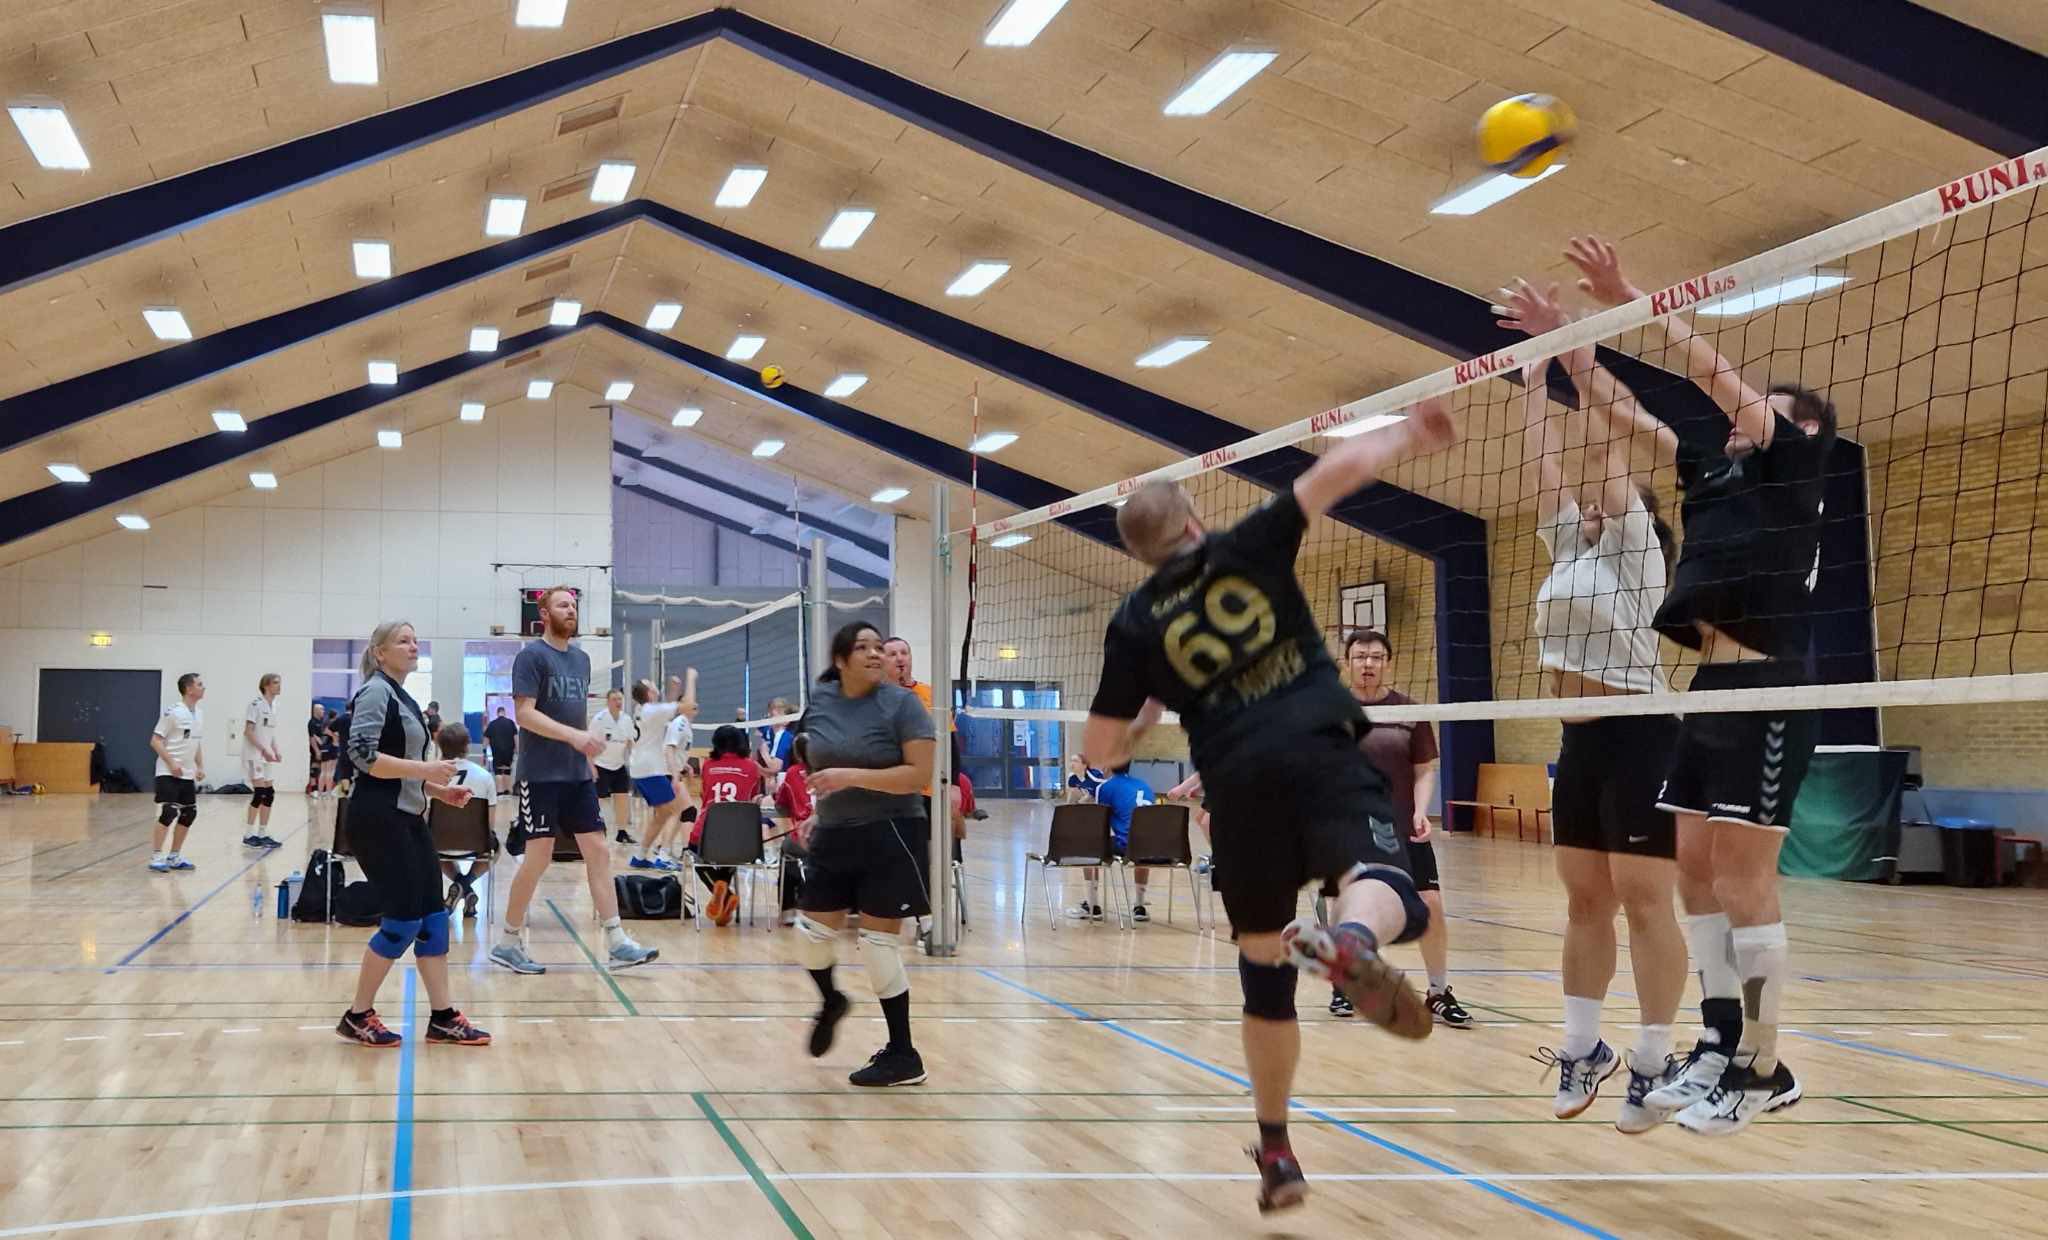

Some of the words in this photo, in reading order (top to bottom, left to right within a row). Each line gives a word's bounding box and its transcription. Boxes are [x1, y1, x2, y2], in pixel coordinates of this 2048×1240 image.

[1938, 157, 2029, 215] RUNI
[1650, 275, 1712, 318] RUNI
[1713, 275, 1737, 295] A/S
[1455, 354, 1498, 385] RUNI
[1164, 576, 1277, 689] 69
